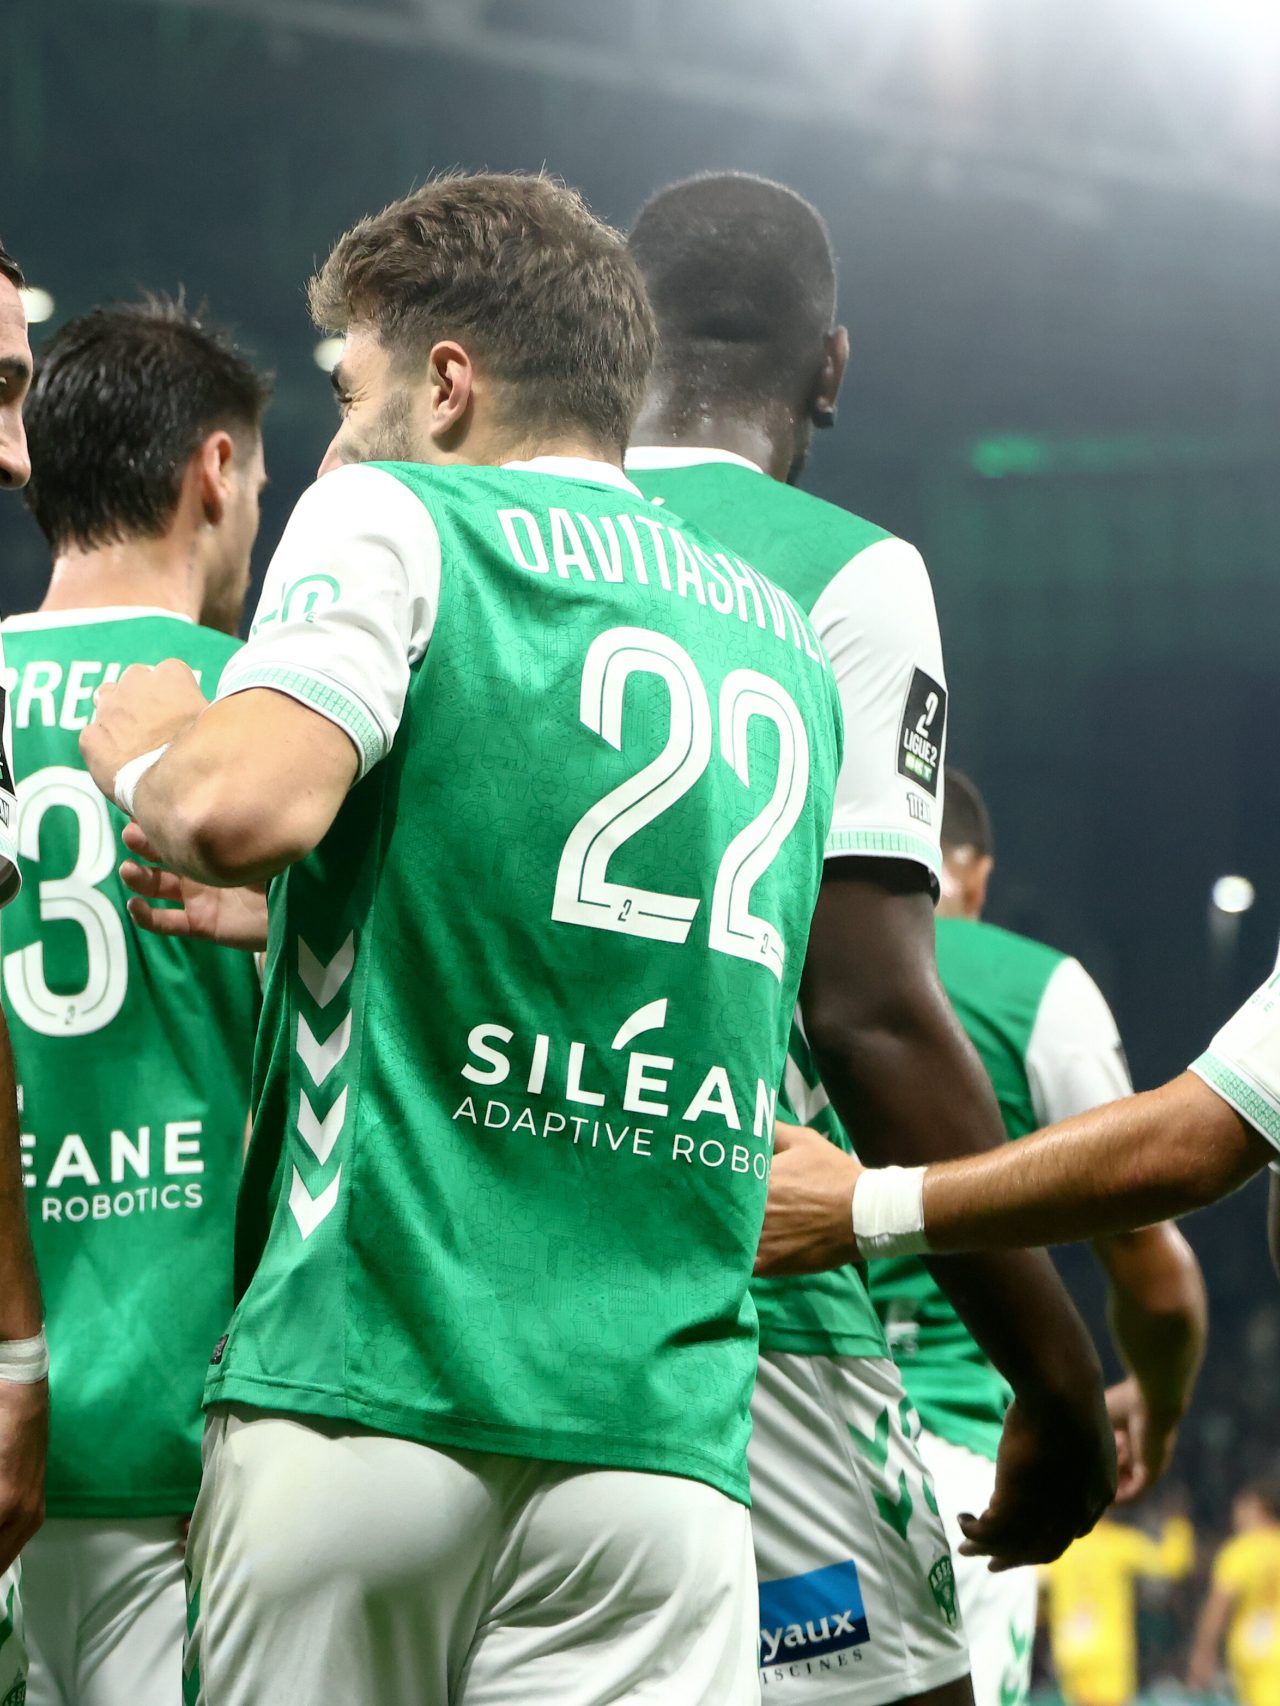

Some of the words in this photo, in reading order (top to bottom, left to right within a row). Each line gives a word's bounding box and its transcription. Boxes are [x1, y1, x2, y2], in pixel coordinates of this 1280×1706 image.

[915, 691, 939, 739] 2
[551, 626, 810, 984] 22
[461, 998, 776, 1147] SILÉAN
[452, 1096, 654, 1157] ADAPTIVE
[672, 1134, 768, 1185] ROBO
[41, 1183, 204, 1224] ROBOTICS
[759, 1609, 857, 1663] yaux
[762, 1648, 863, 1685] ISCINES
